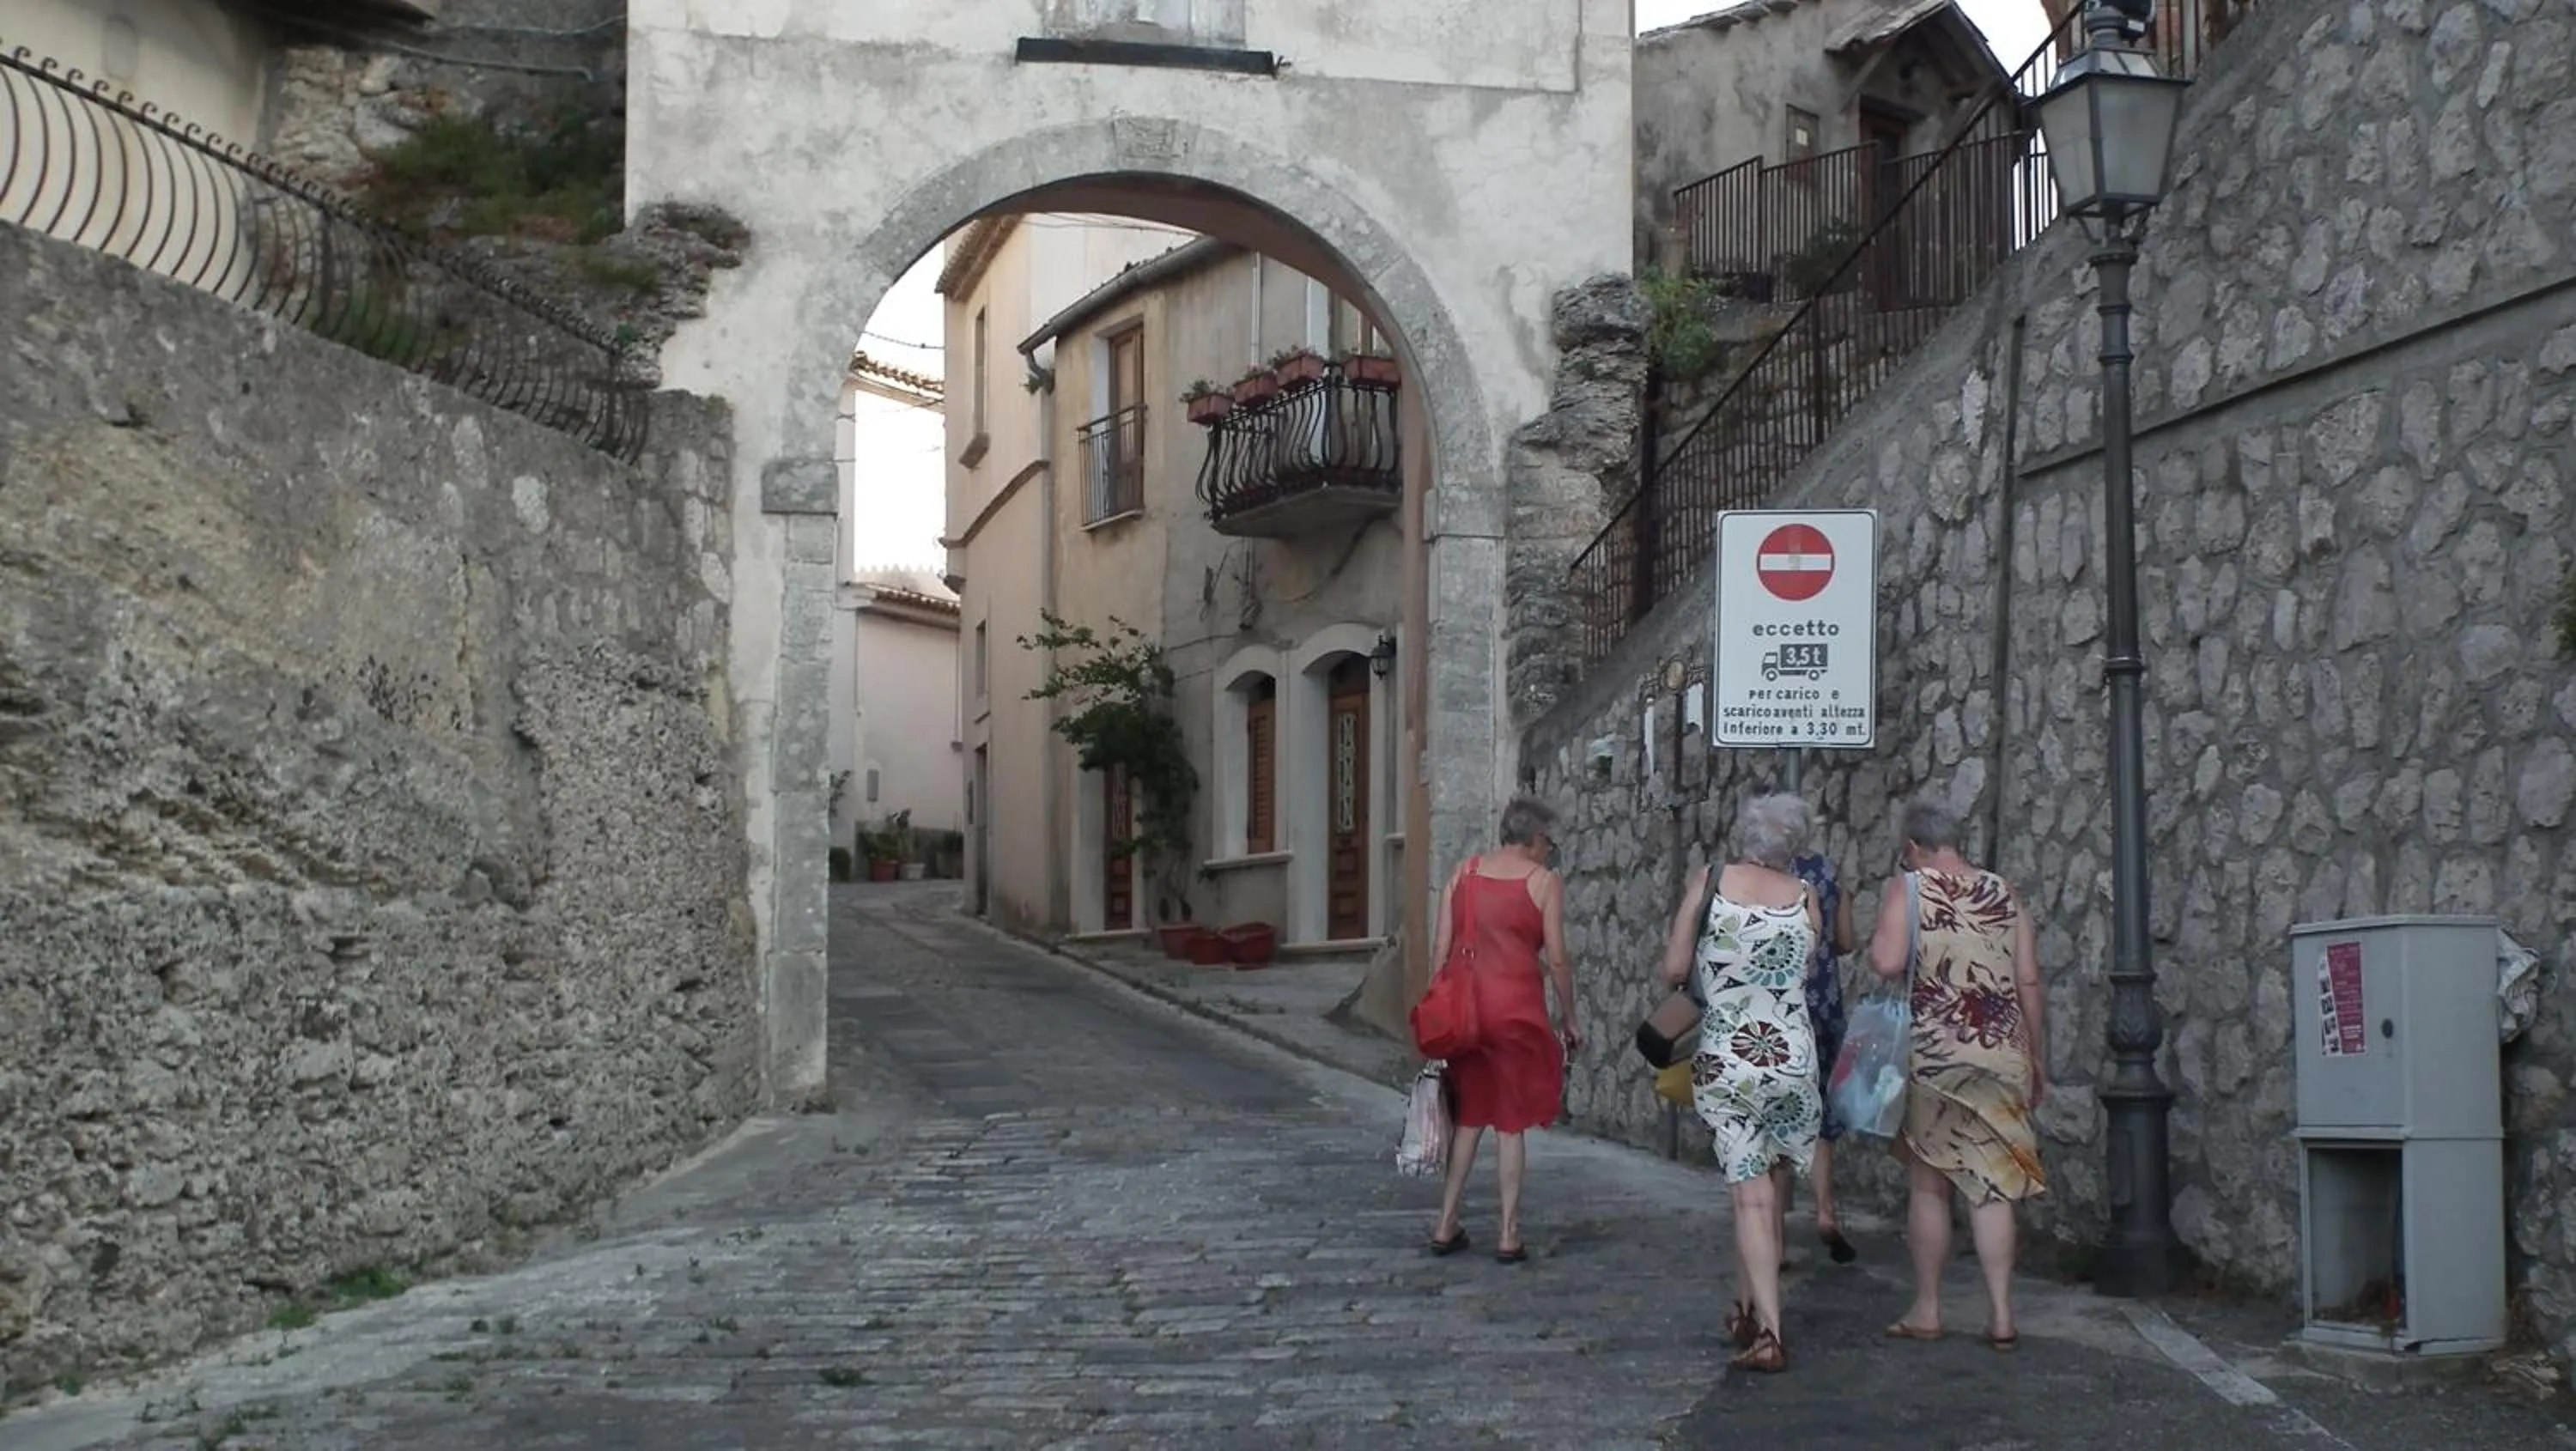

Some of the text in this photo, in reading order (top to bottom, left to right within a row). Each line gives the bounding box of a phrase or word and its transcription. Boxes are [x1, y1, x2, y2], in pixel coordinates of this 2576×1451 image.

[1753, 619, 1839, 636] eccetto
[1749, 686, 1839, 700] per carico e
[1723, 703, 1771, 718] scarico
[1821, 704, 1866, 719] altezza
[1791, 726, 1798, 735] a
